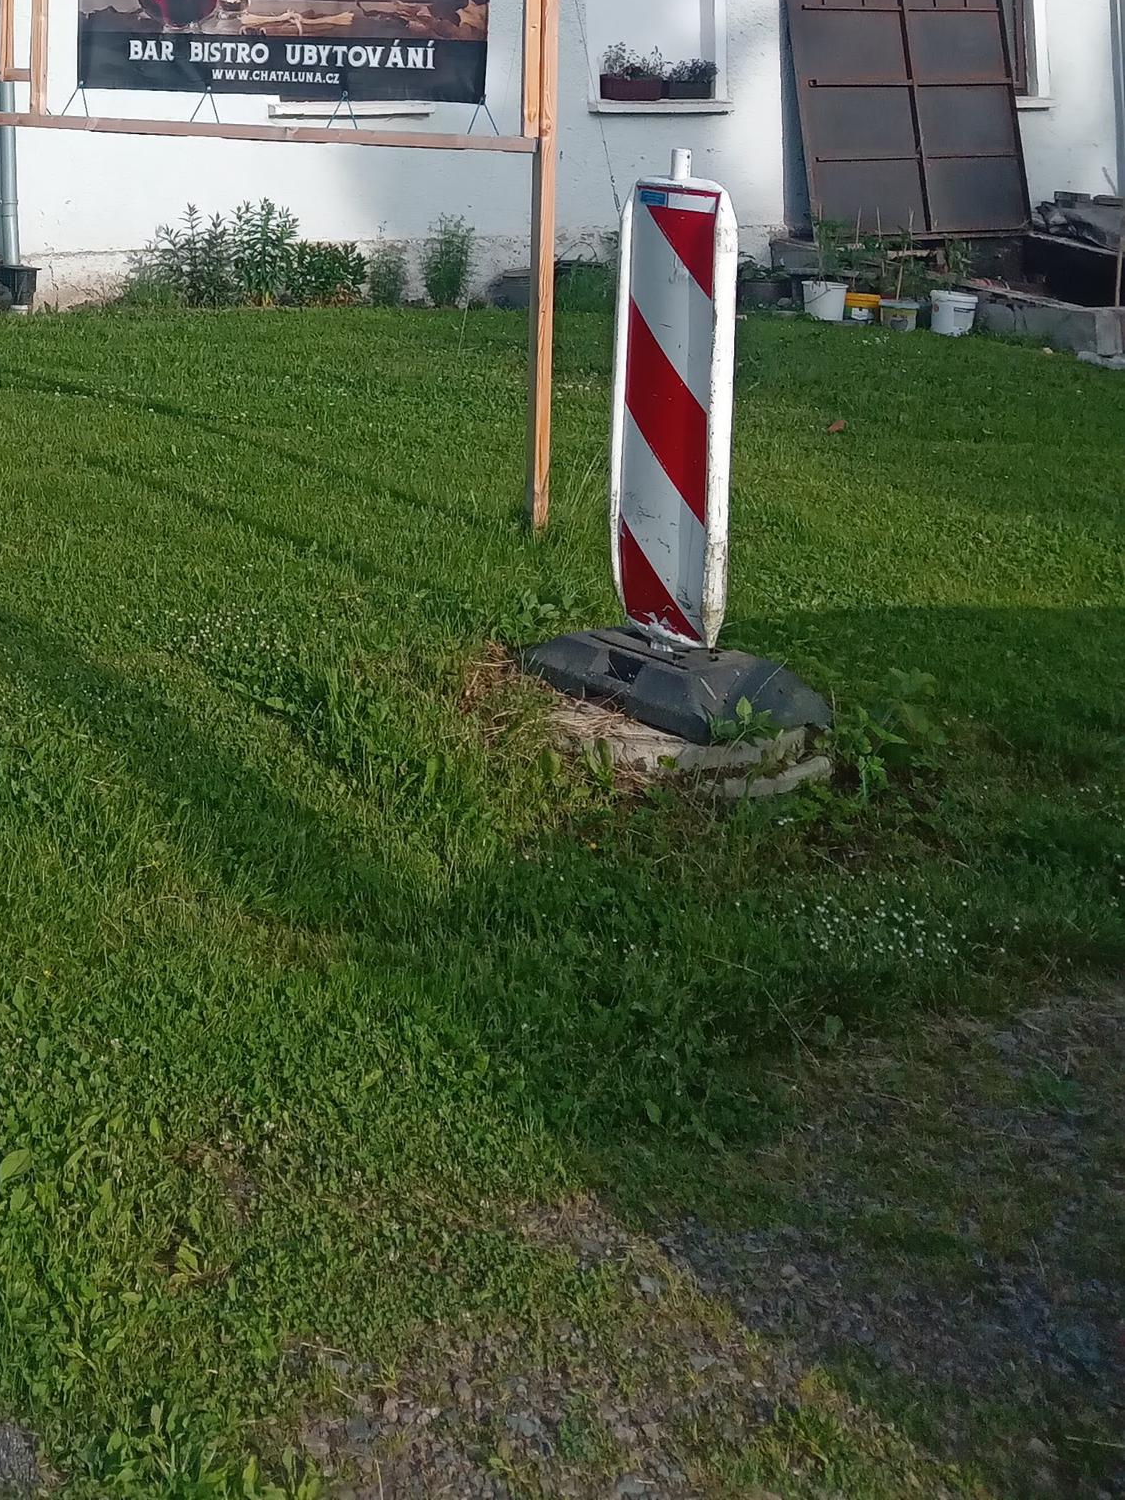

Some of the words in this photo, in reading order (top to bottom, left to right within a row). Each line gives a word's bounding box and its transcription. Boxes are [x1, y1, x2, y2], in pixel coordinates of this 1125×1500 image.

[128, 39, 175, 62] BAR
[189, 41, 270, 65] BISTRO
[285, 38, 436, 70] UBYTOVÁNÍ
[211, 68, 340, 85] WWW.CHATALUNA.CZ
